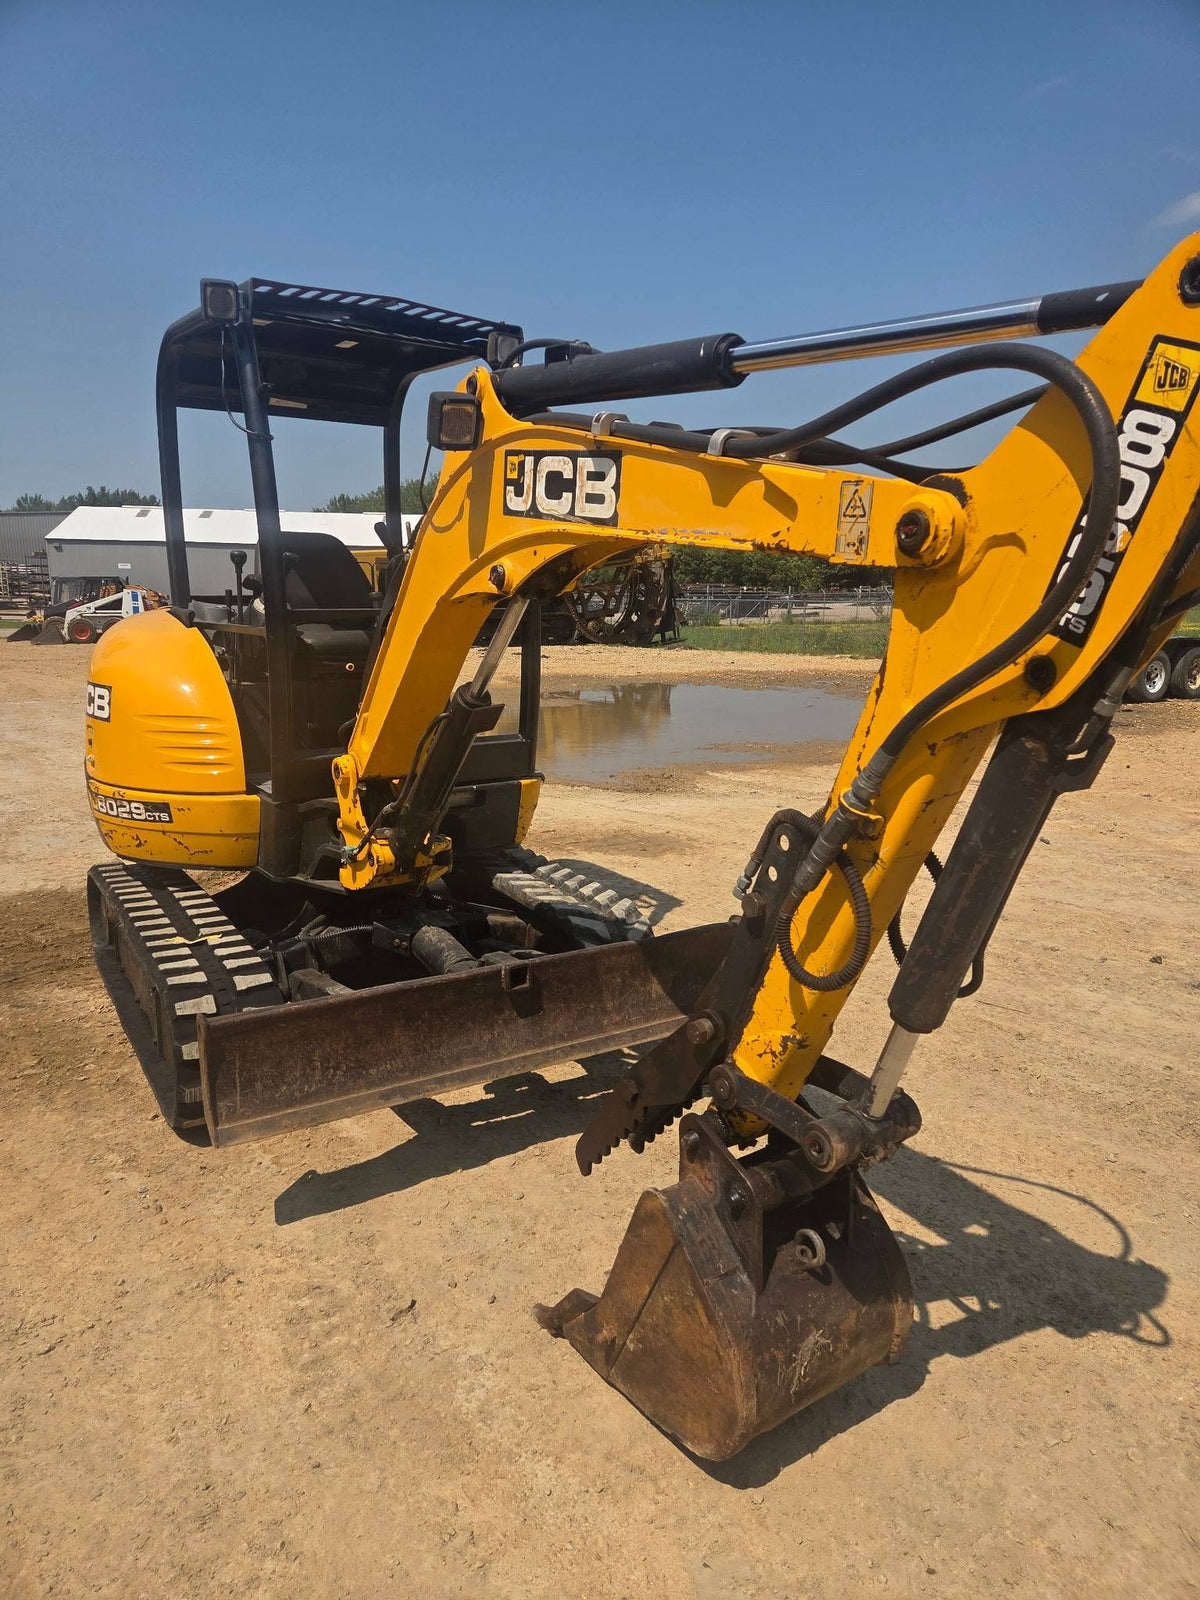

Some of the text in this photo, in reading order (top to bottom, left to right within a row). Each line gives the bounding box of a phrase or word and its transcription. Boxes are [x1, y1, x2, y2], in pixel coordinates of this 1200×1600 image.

[1157, 361, 1188, 389] JCB
[506, 456, 617, 519] JCB
[87, 685, 110, 718] CB
